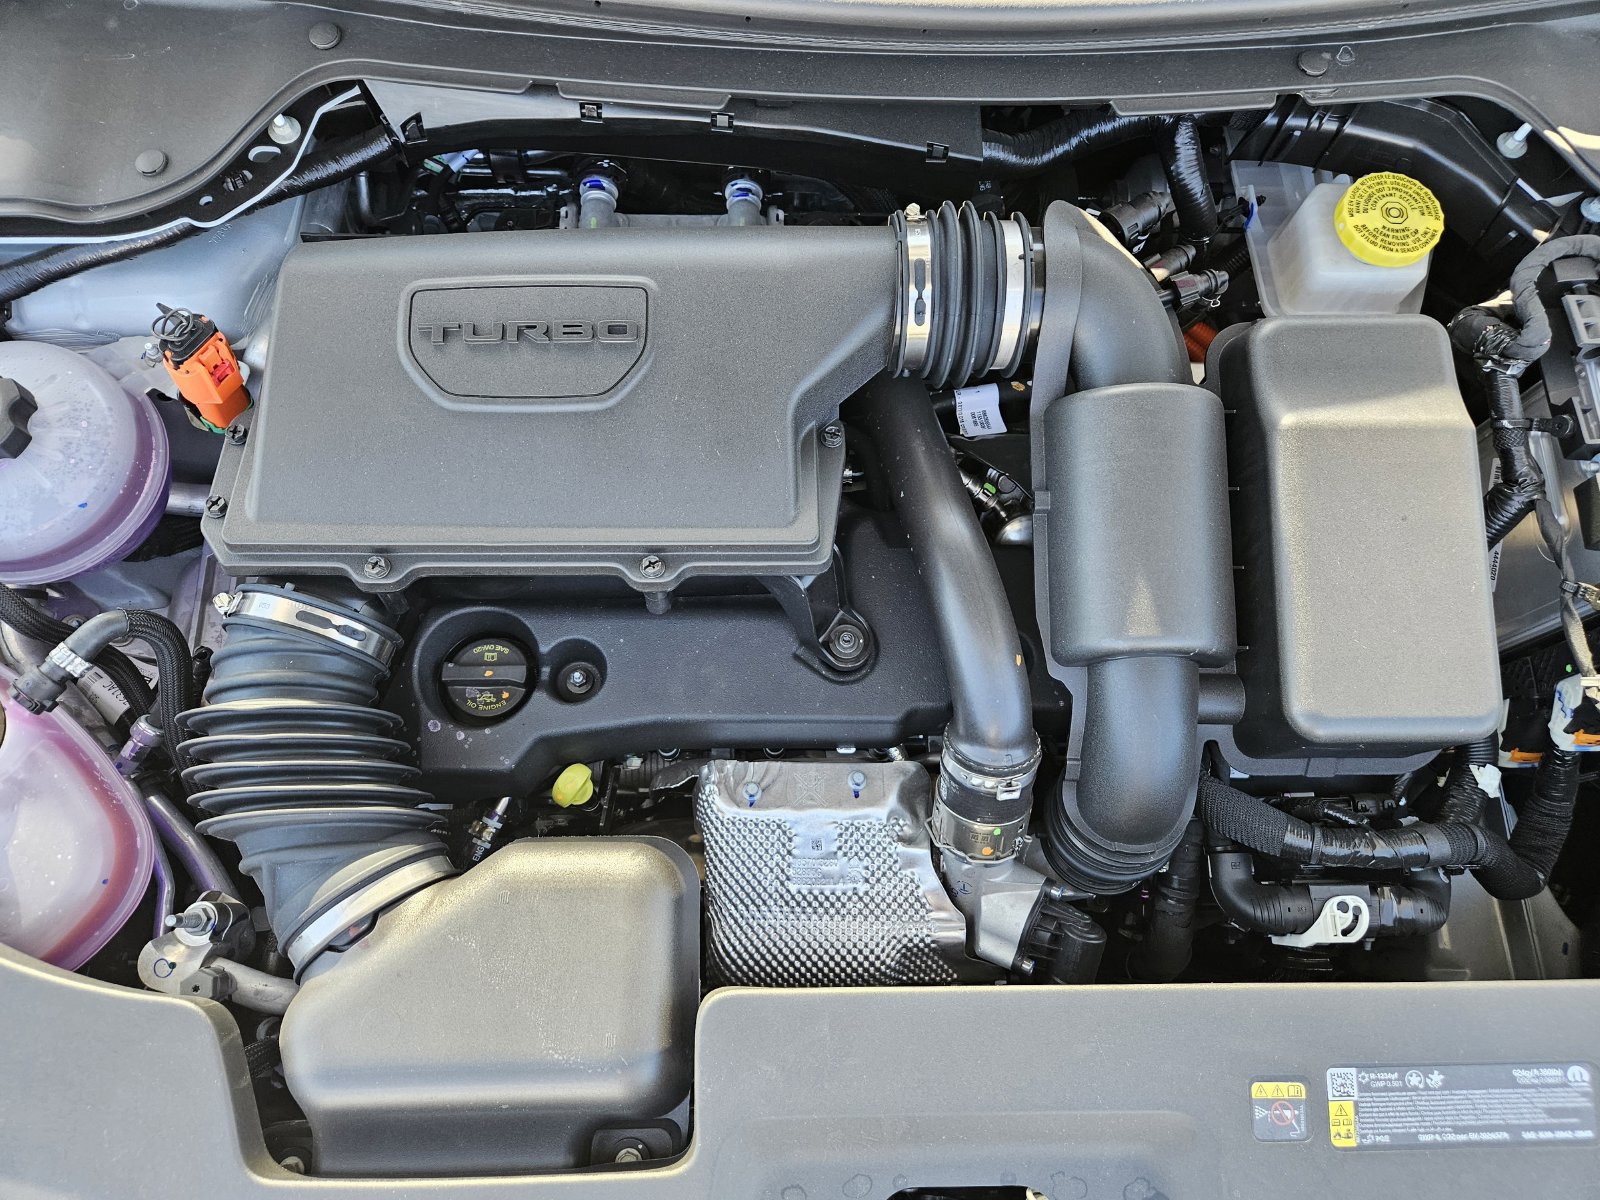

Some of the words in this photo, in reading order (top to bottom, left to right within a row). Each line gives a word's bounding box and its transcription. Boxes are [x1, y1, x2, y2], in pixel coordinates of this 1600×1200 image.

[1353, 224, 1363, 234] DOT
[1364, 236, 1379, 247] FLUID
[1378, 244, 1394, 252] FROM
[1360, 224, 1379, 240] BEFORE
[1412, 236, 1423, 245] USE
[1420, 227, 1431, 239] ONLY
[1373, 227, 1391, 239] CLEAN
[1410, 228, 1420, 237] CAP
[416, 320, 640, 346] TURBO
[1490, 550, 1500, 580] 4444020
[472, 644, 495, 654] 0W-20
[495, 644, 510, 654] SAE
[466, 699, 477, 709] OIL
[478, 700, 507, 711] ENGINE
[472, 846, 485, 862] ENG
